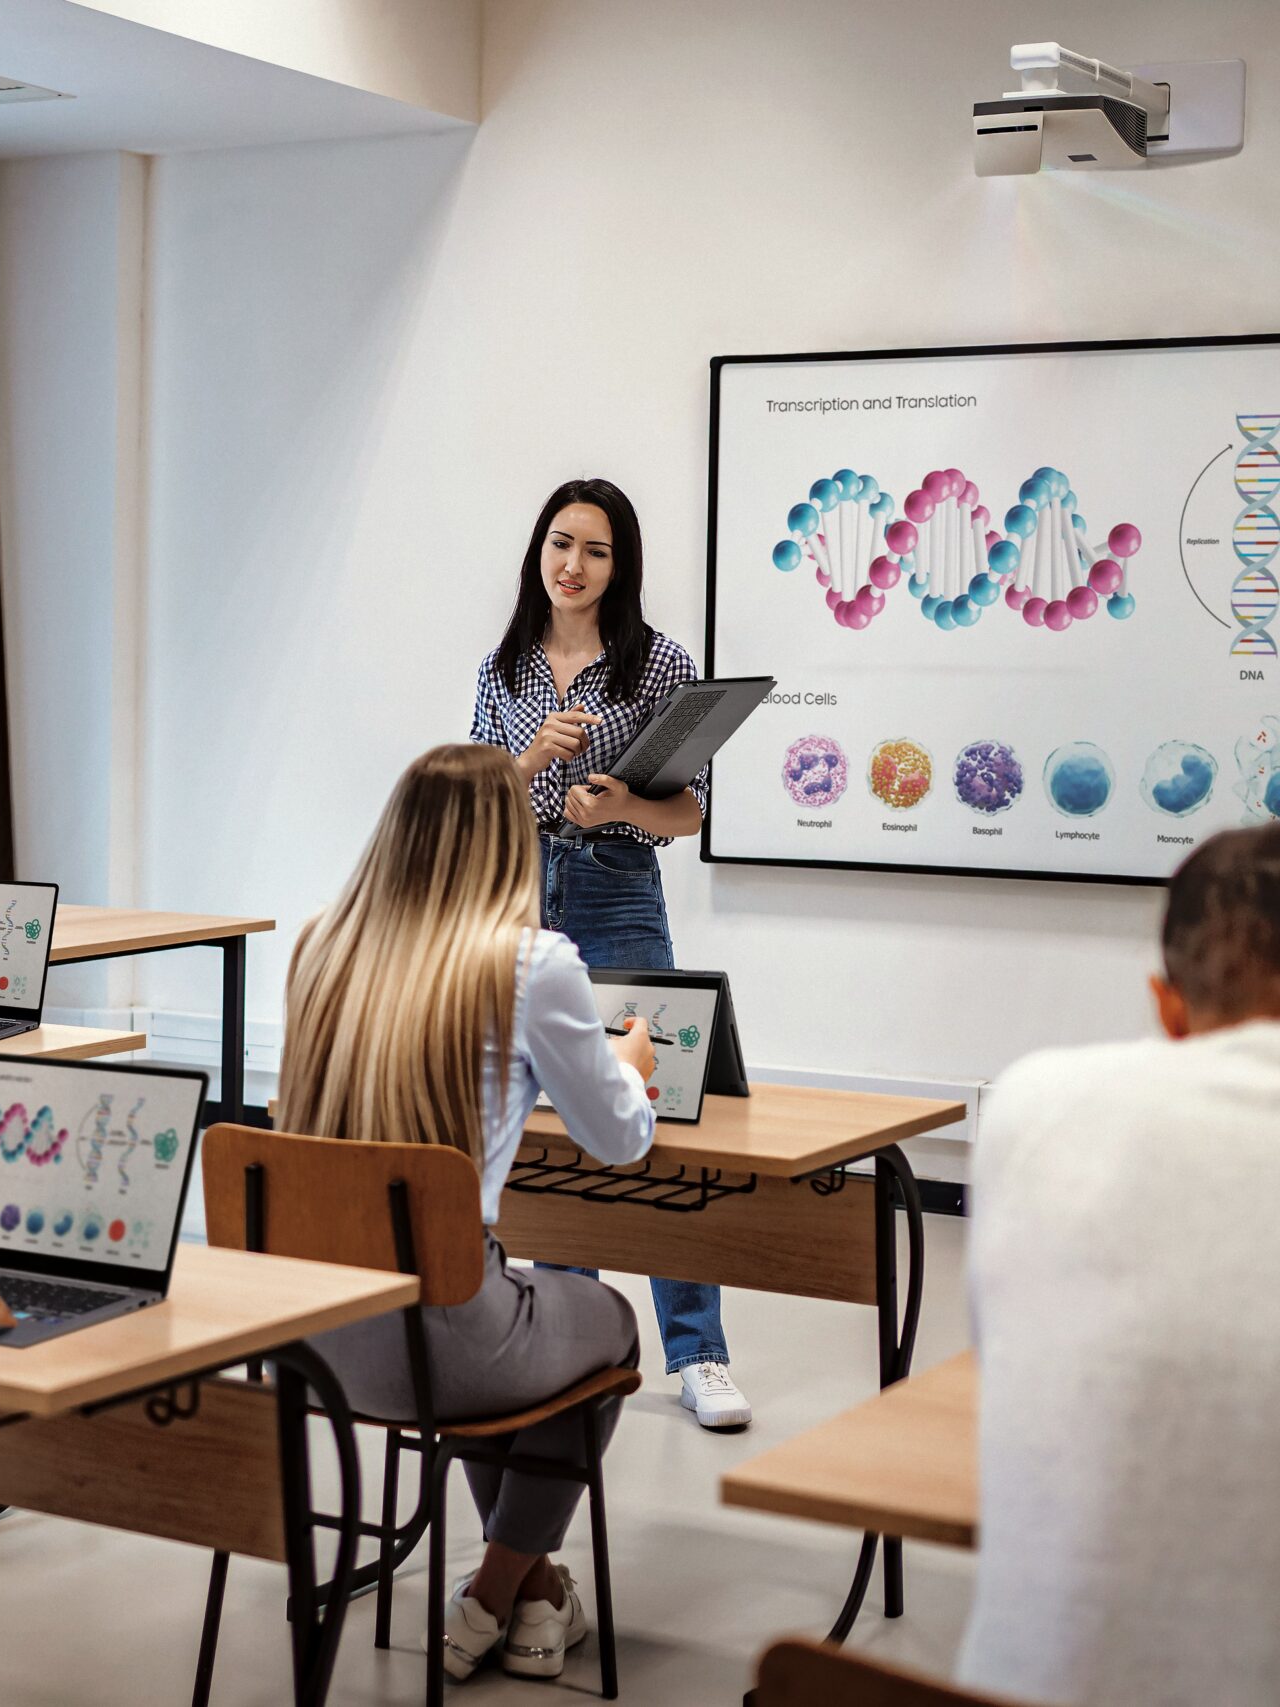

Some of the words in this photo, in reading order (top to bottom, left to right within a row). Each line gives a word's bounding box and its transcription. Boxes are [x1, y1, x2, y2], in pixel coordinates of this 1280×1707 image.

[766, 397, 859, 415] Transcription
[862, 396, 892, 410] and
[895, 393, 977, 409] Translation
[1186, 538, 1220, 546] Replication
[1239, 669, 1265, 681] DNA
[804, 692, 838, 706] Cells
[796, 818, 832, 829] Neutrophil
[881, 822, 918, 833] Eosinophil
[972, 826, 1003, 837] Basophil
[1055, 830, 1101, 841] Lymphocyte
[1156, 834, 1195, 845] Monocyte
